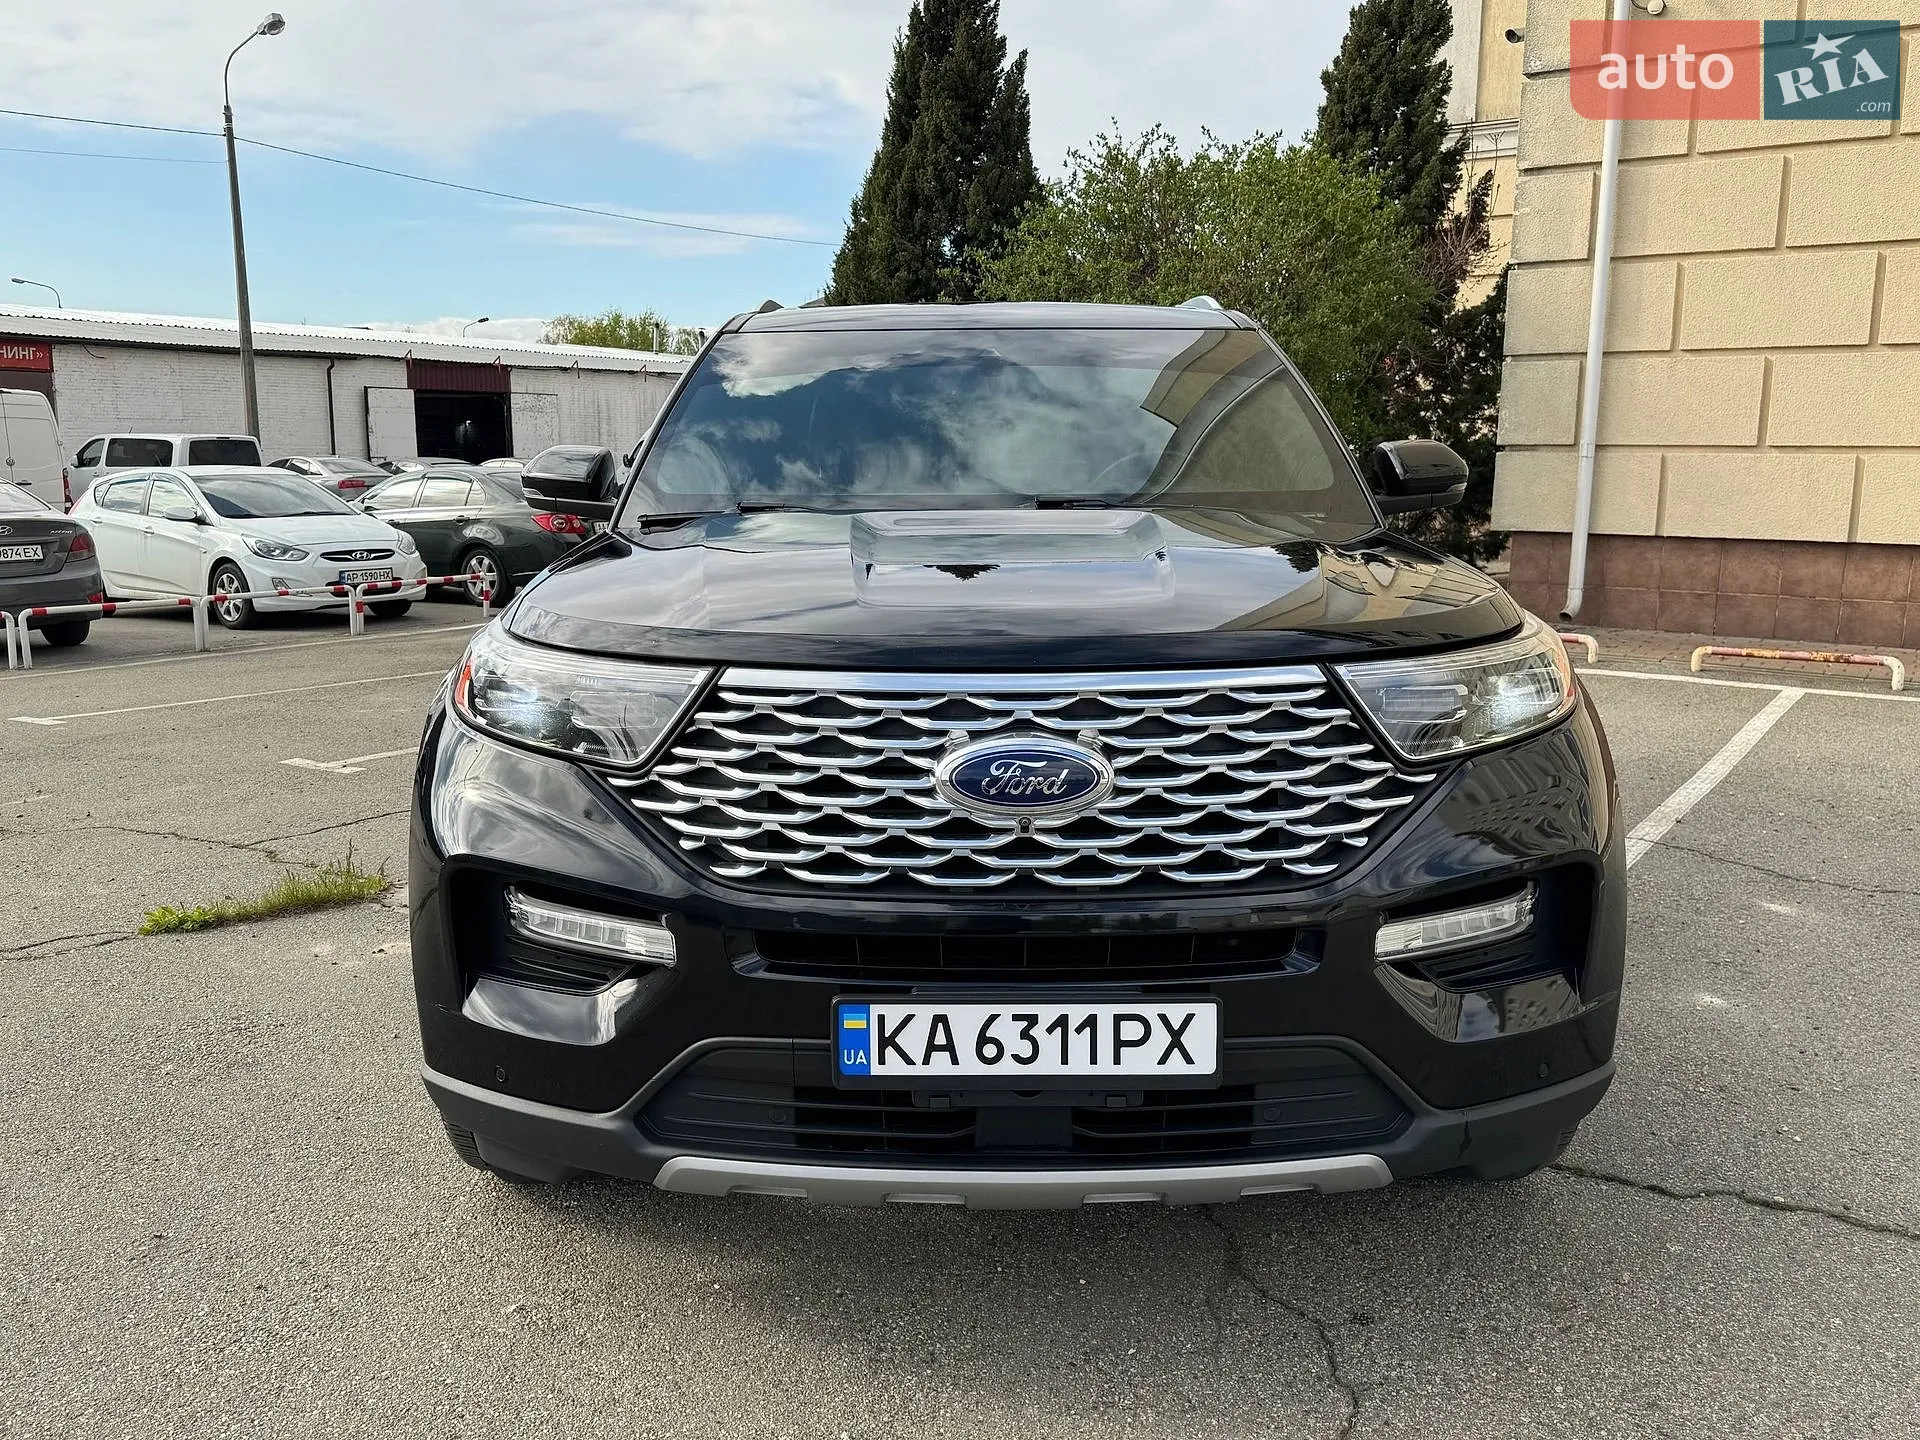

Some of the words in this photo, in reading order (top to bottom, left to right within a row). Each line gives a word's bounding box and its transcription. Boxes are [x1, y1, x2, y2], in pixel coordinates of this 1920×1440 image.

[0, 547, 21, 559] 874
[23, 547, 40, 558] EX
[981, 759, 1068, 795] Ford
[877, 1013, 960, 1066] KA
[975, 1013, 1099, 1066] 6311
[1112, 1013, 1196, 1066] PX
[844, 1049, 868, 1065] UA
